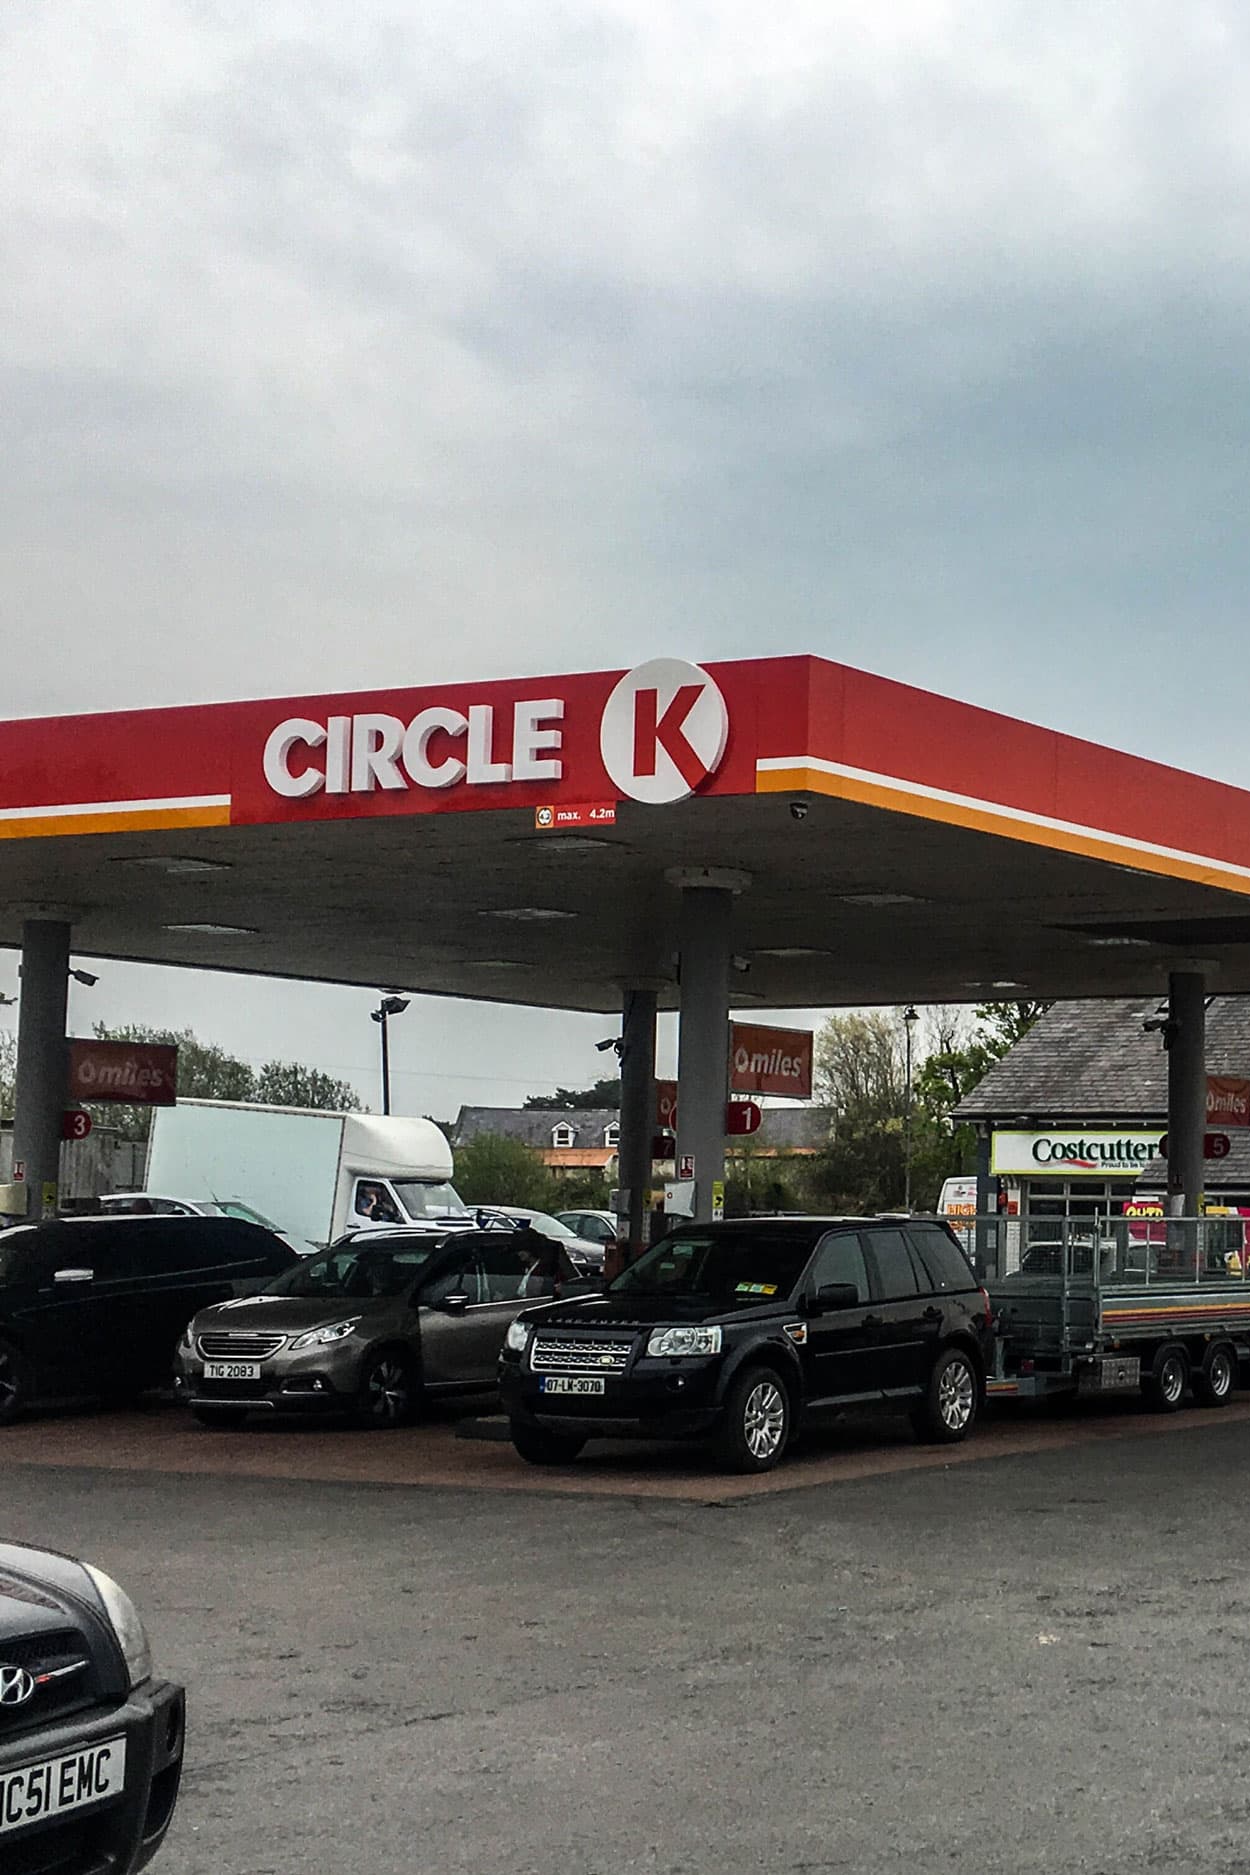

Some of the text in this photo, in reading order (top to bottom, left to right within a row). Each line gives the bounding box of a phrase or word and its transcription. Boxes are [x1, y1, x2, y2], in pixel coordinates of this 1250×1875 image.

[263, 684, 713, 797] CIRCLE K
[557, 809, 615, 821] max. 4.2m
[99, 1061, 163, 1087] miles
[750, 1050, 801, 1077] miles
[1215, 1092, 1247, 1114] miles
[73, 1115, 86, 1135] 3
[741, 1107, 752, 1130] 1
[1032, 1138, 1159, 1162] Costcutter
[1213, 1137, 1225, 1155] 5
[0, 1748, 111, 1827] C51 EMC
